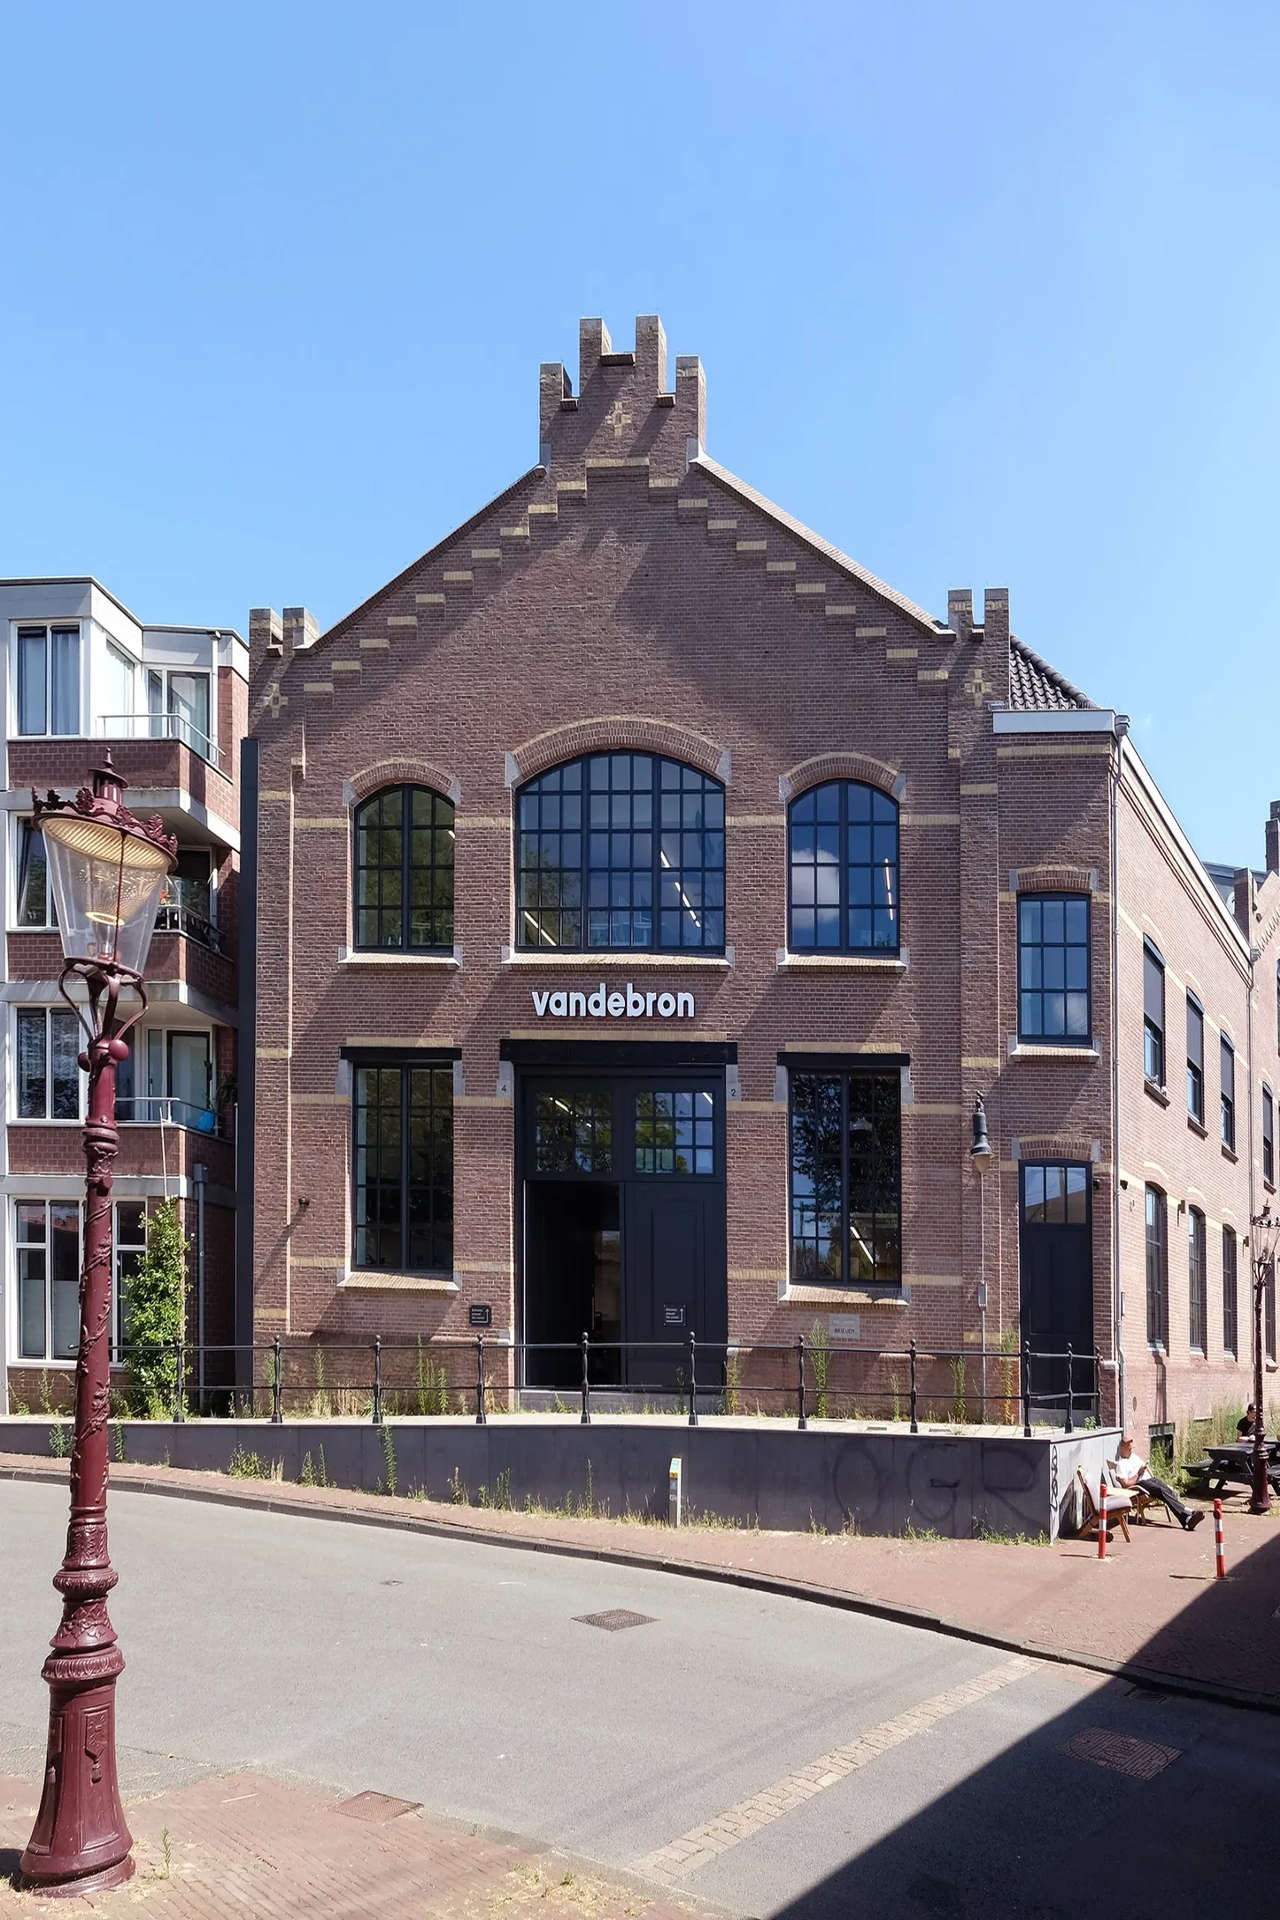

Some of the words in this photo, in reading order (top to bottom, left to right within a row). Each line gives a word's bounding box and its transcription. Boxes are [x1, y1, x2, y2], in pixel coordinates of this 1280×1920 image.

[531, 983, 695, 1016] vandebron
[501, 1084, 507, 1093] 4
[730, 1088, 736, 1096] 2
